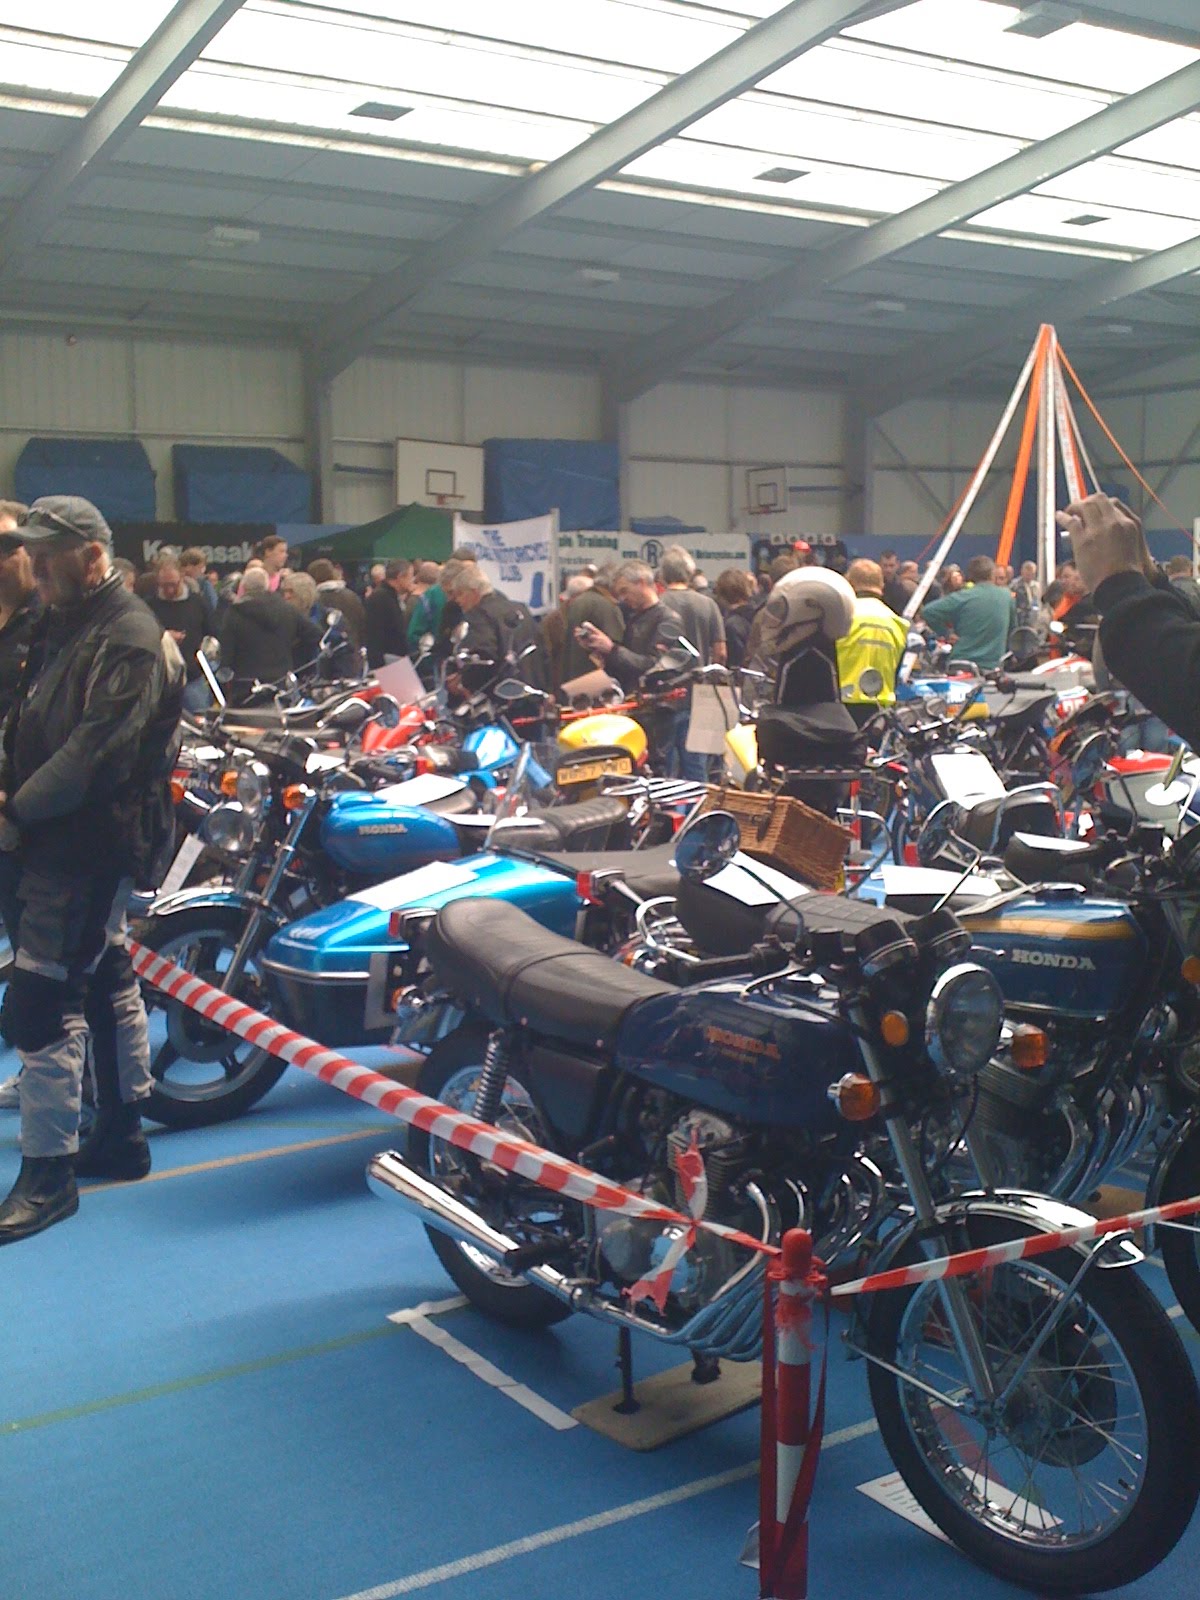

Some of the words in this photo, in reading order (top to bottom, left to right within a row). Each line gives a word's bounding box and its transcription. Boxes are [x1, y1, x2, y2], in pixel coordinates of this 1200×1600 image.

[577, 534, 618, 550] Training
[359, 823, 409, 836] HONDA
[1011, 948, 1097, 972] HONDA
[706, 1025, 781, 1061] HONDA
